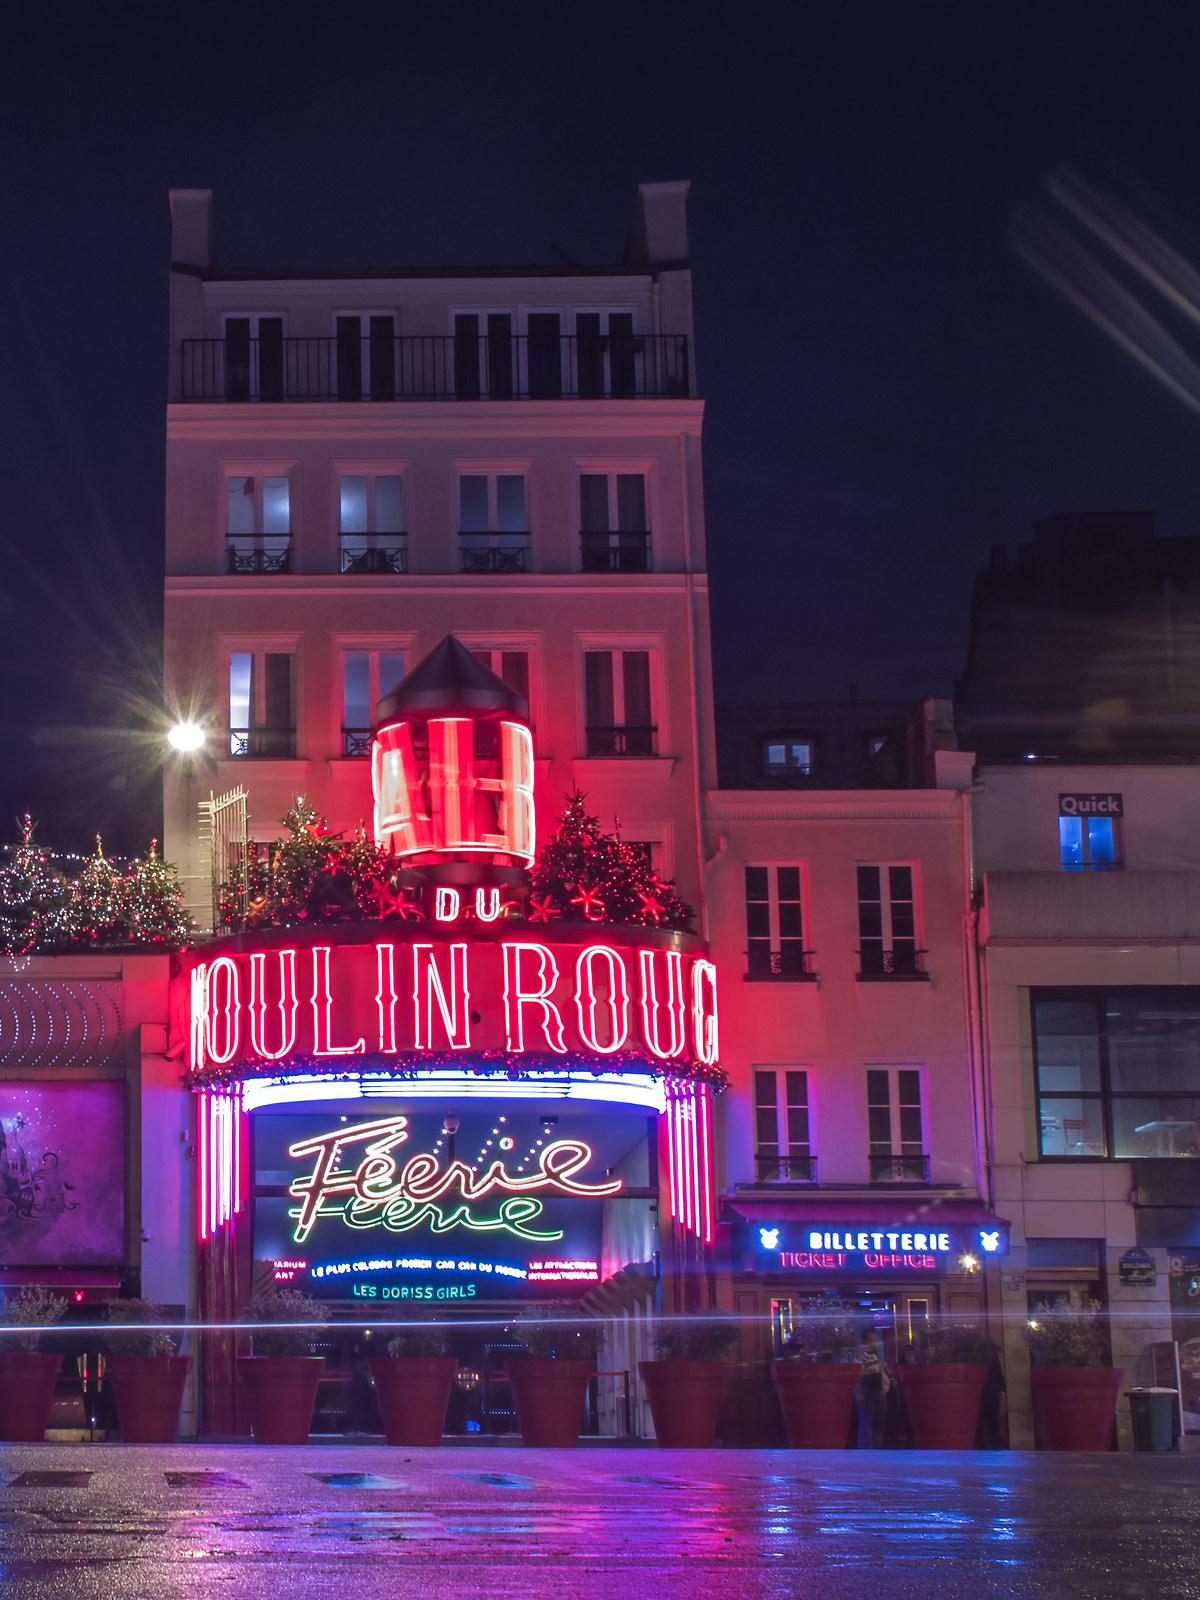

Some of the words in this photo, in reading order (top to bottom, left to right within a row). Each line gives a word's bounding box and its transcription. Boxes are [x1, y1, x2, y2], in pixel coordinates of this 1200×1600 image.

[1061, 796, 1120, 815] Quick
[436, 888, 500, 922] DU
[809, 1232, 950, 1251] BILLETTERIE
[779, 1252, 847, 1268] TICKET
[864, 1253, 936, 1268] OFFICE
[353, 1283, 377, 1298] LES
[382, 1286, 433, 1299] DORISS
[436, 1284, 476, 1299] GIRLS
